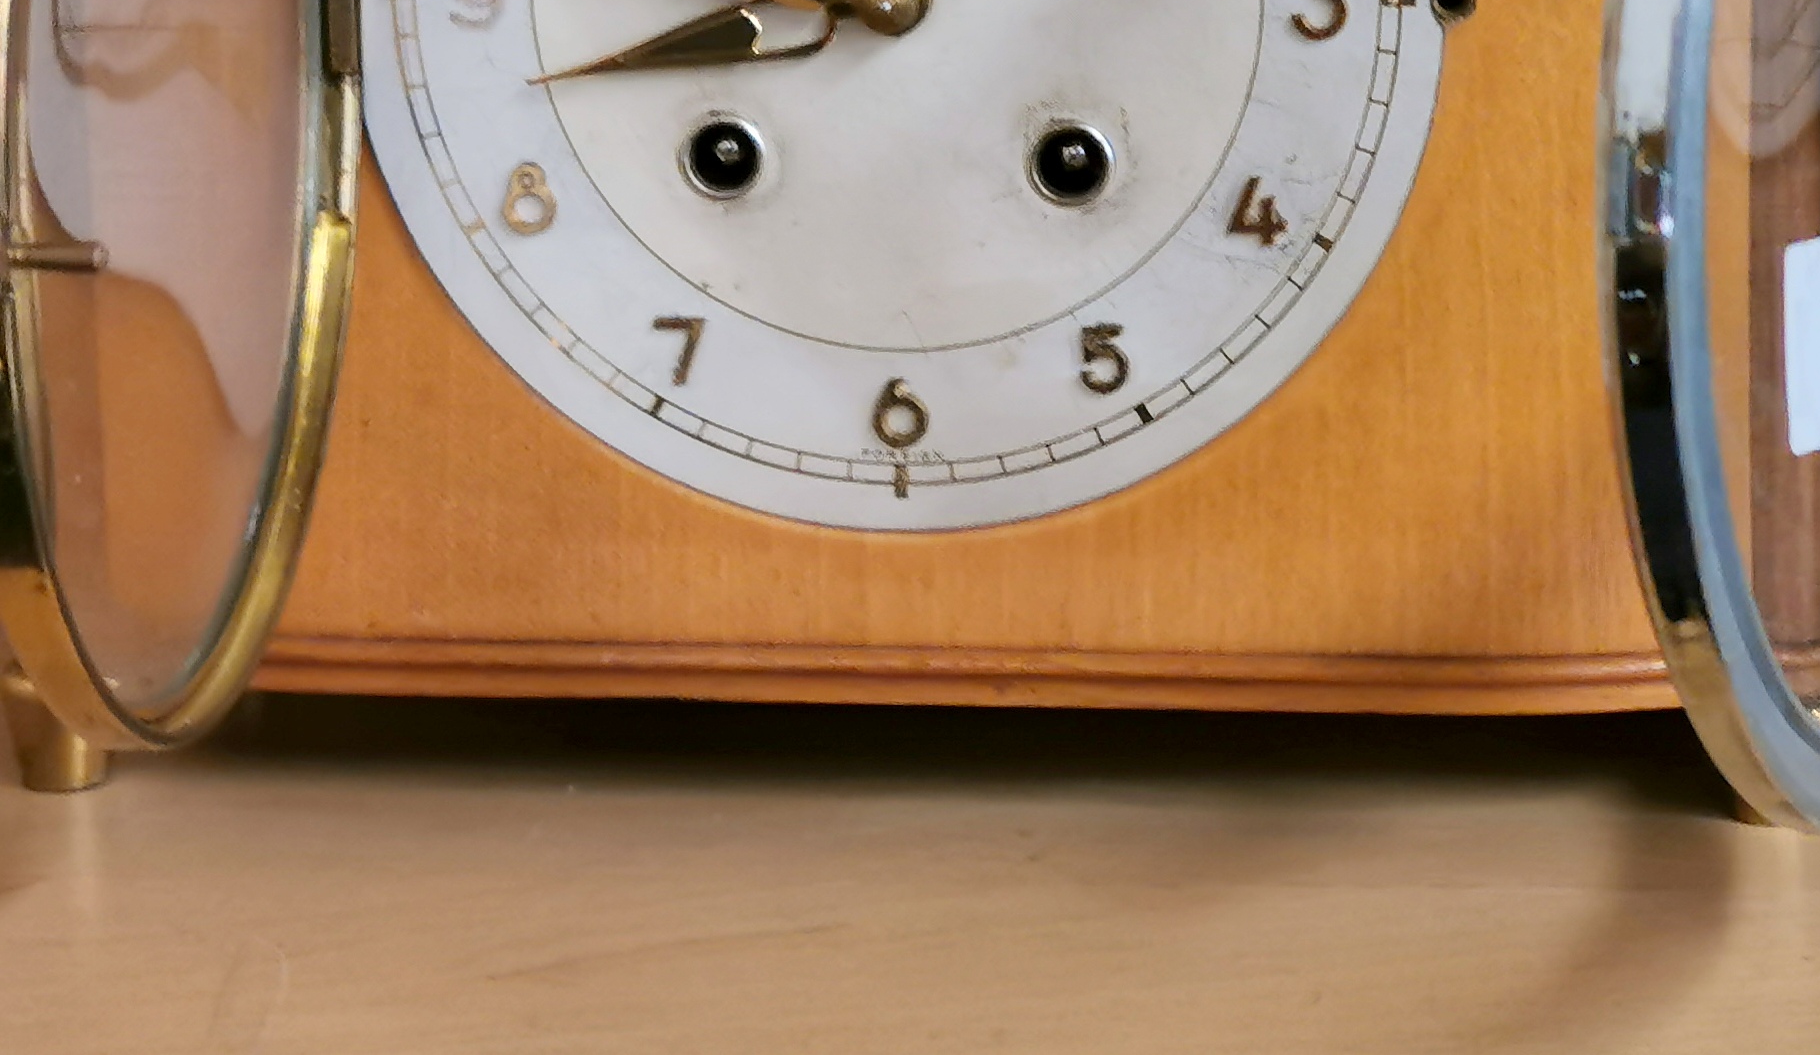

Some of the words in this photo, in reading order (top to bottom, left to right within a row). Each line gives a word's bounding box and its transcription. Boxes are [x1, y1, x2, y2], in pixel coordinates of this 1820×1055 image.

[503, 163, 556, 232] 8
[1229, 177, 1286, 244] 4
[653, 317, 704, 384] 7
[1081, 324, 1128, 393] 5
[872, 379, 929, 448] 6
